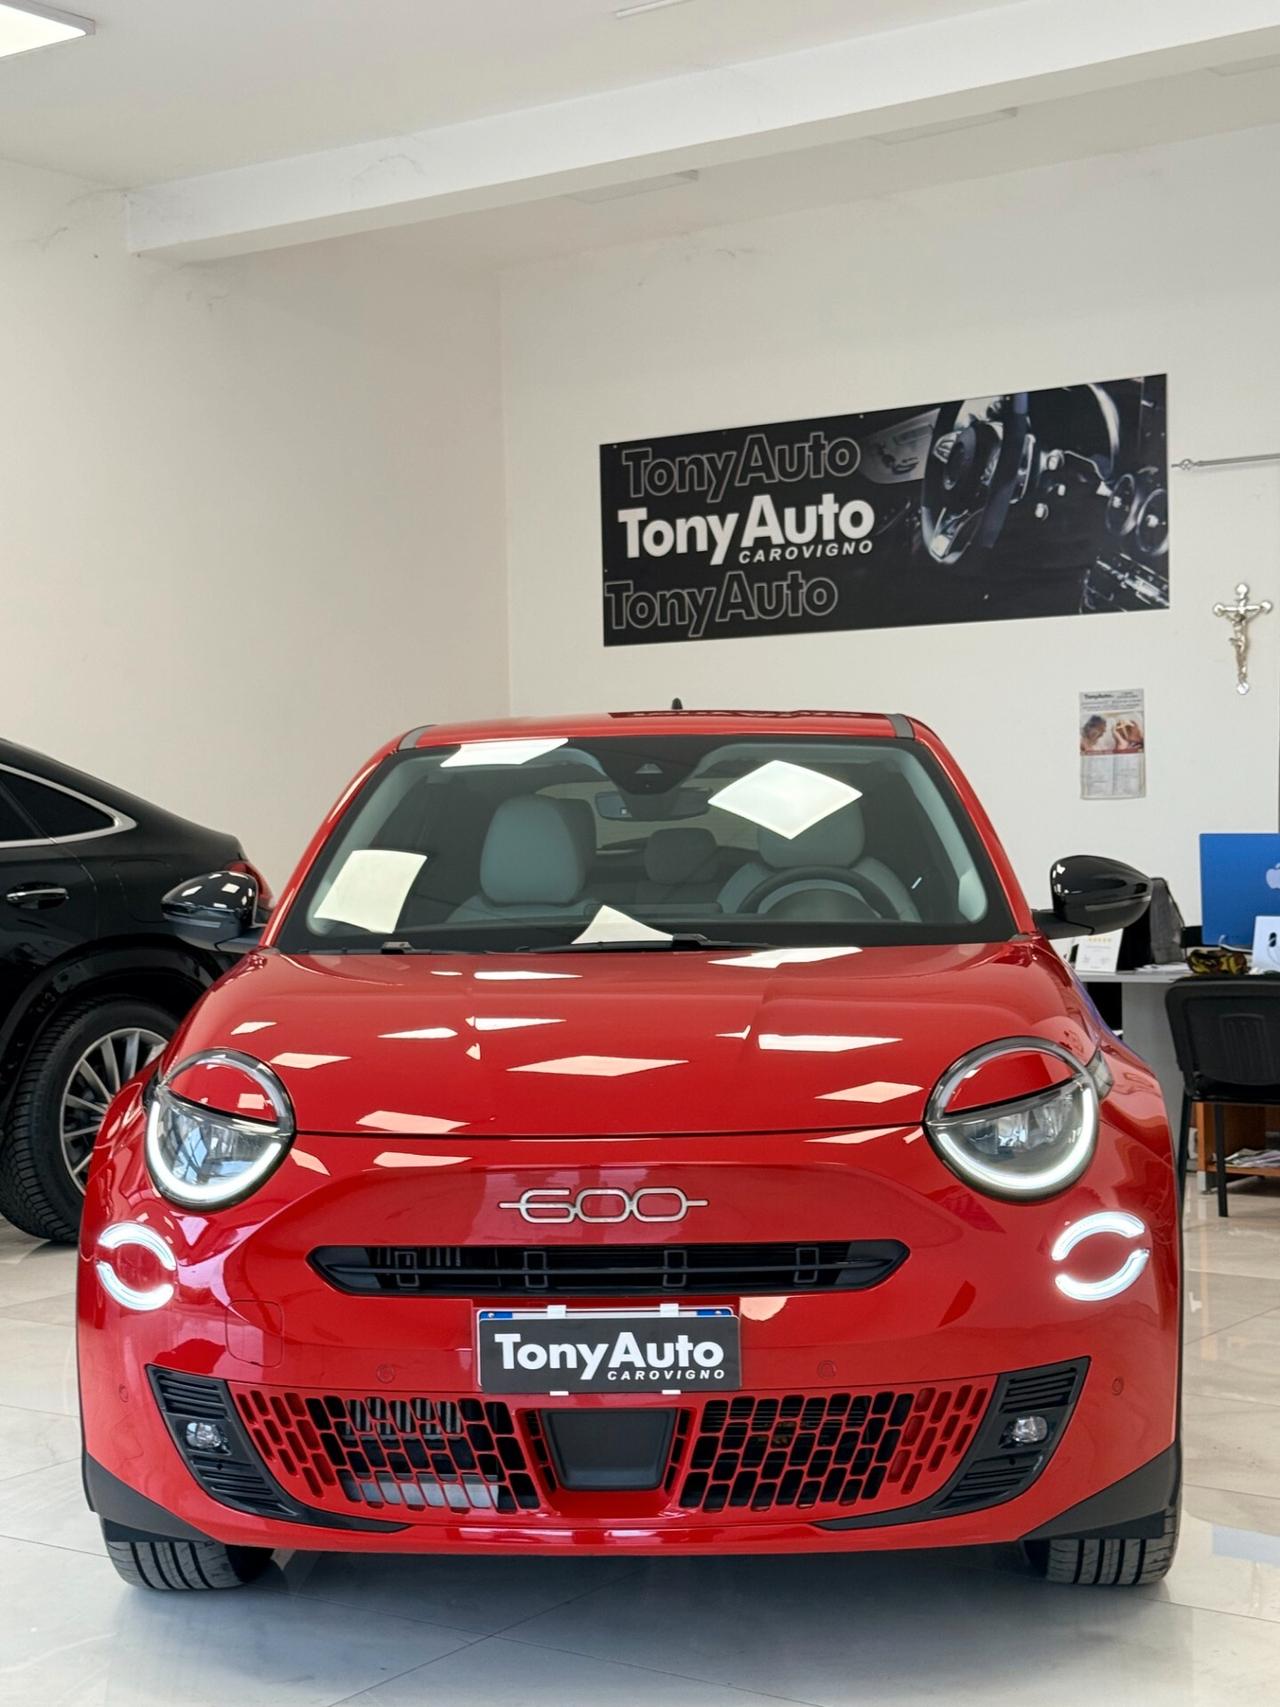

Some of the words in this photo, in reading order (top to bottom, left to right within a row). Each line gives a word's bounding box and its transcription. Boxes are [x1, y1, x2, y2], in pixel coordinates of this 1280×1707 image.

[738, 540, 873, 565] CAROVIGNO
[512, 1187, 695, 1224] 600
[607, 1369, 725, 1381] CAROVIGNO
